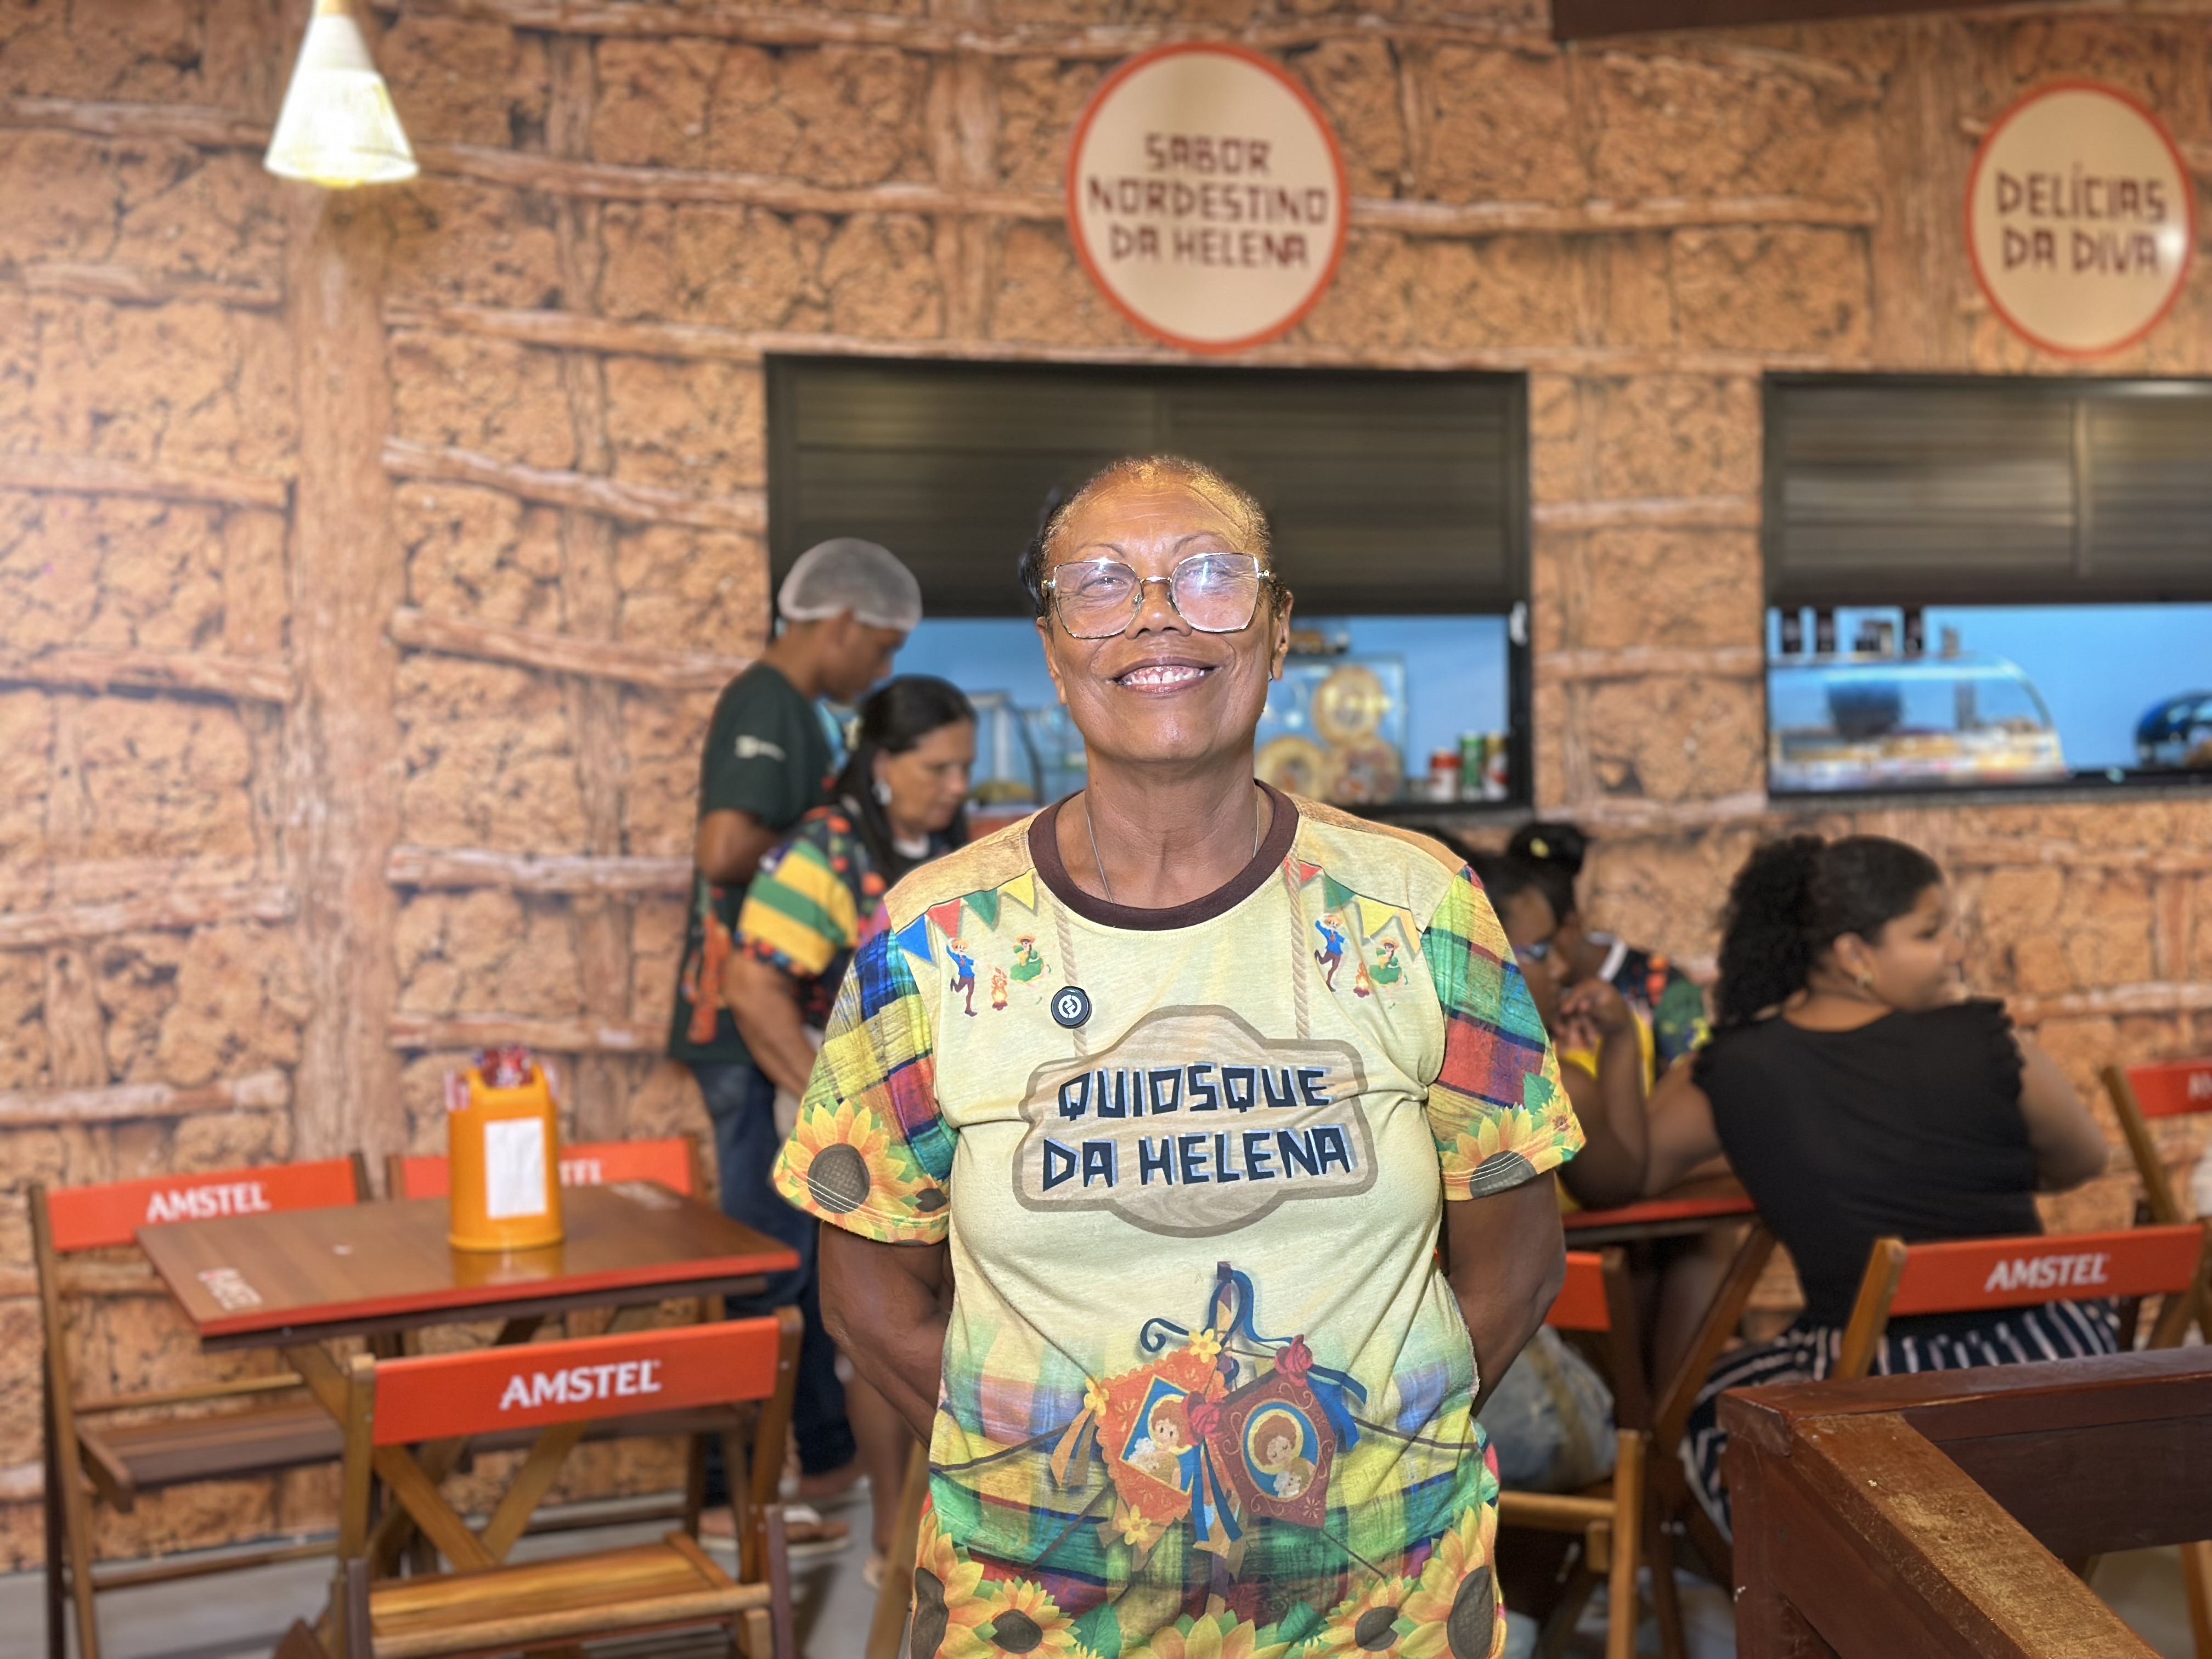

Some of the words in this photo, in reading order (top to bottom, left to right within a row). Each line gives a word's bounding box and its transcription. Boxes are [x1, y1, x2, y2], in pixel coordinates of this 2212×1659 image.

[1145, 132, 1270, 175] SABOR
[1088, 175, 1328, 225] NORDESTINO
[1996, 160, 2166, 224] DELÍCIAS
[1110, 223, 1160, 262] DA
[1173, 228, 1308, 269] HELENA
[2003, 225, 2056, 270] DA
[2072, 228, 2160, 274] DIVA
[1059, 1062, 1335, 1121] QUIOSQUE
[1043, 1136, 1118, 1192] DA
[1138, 1124, 1358, 1185] HELENA
[146, 1181, 272, 1223] AMSTEL
[1984, 1252, 2109, 1292] AMSTEL
[499, 1359, 662, 1410] AMSTEL
